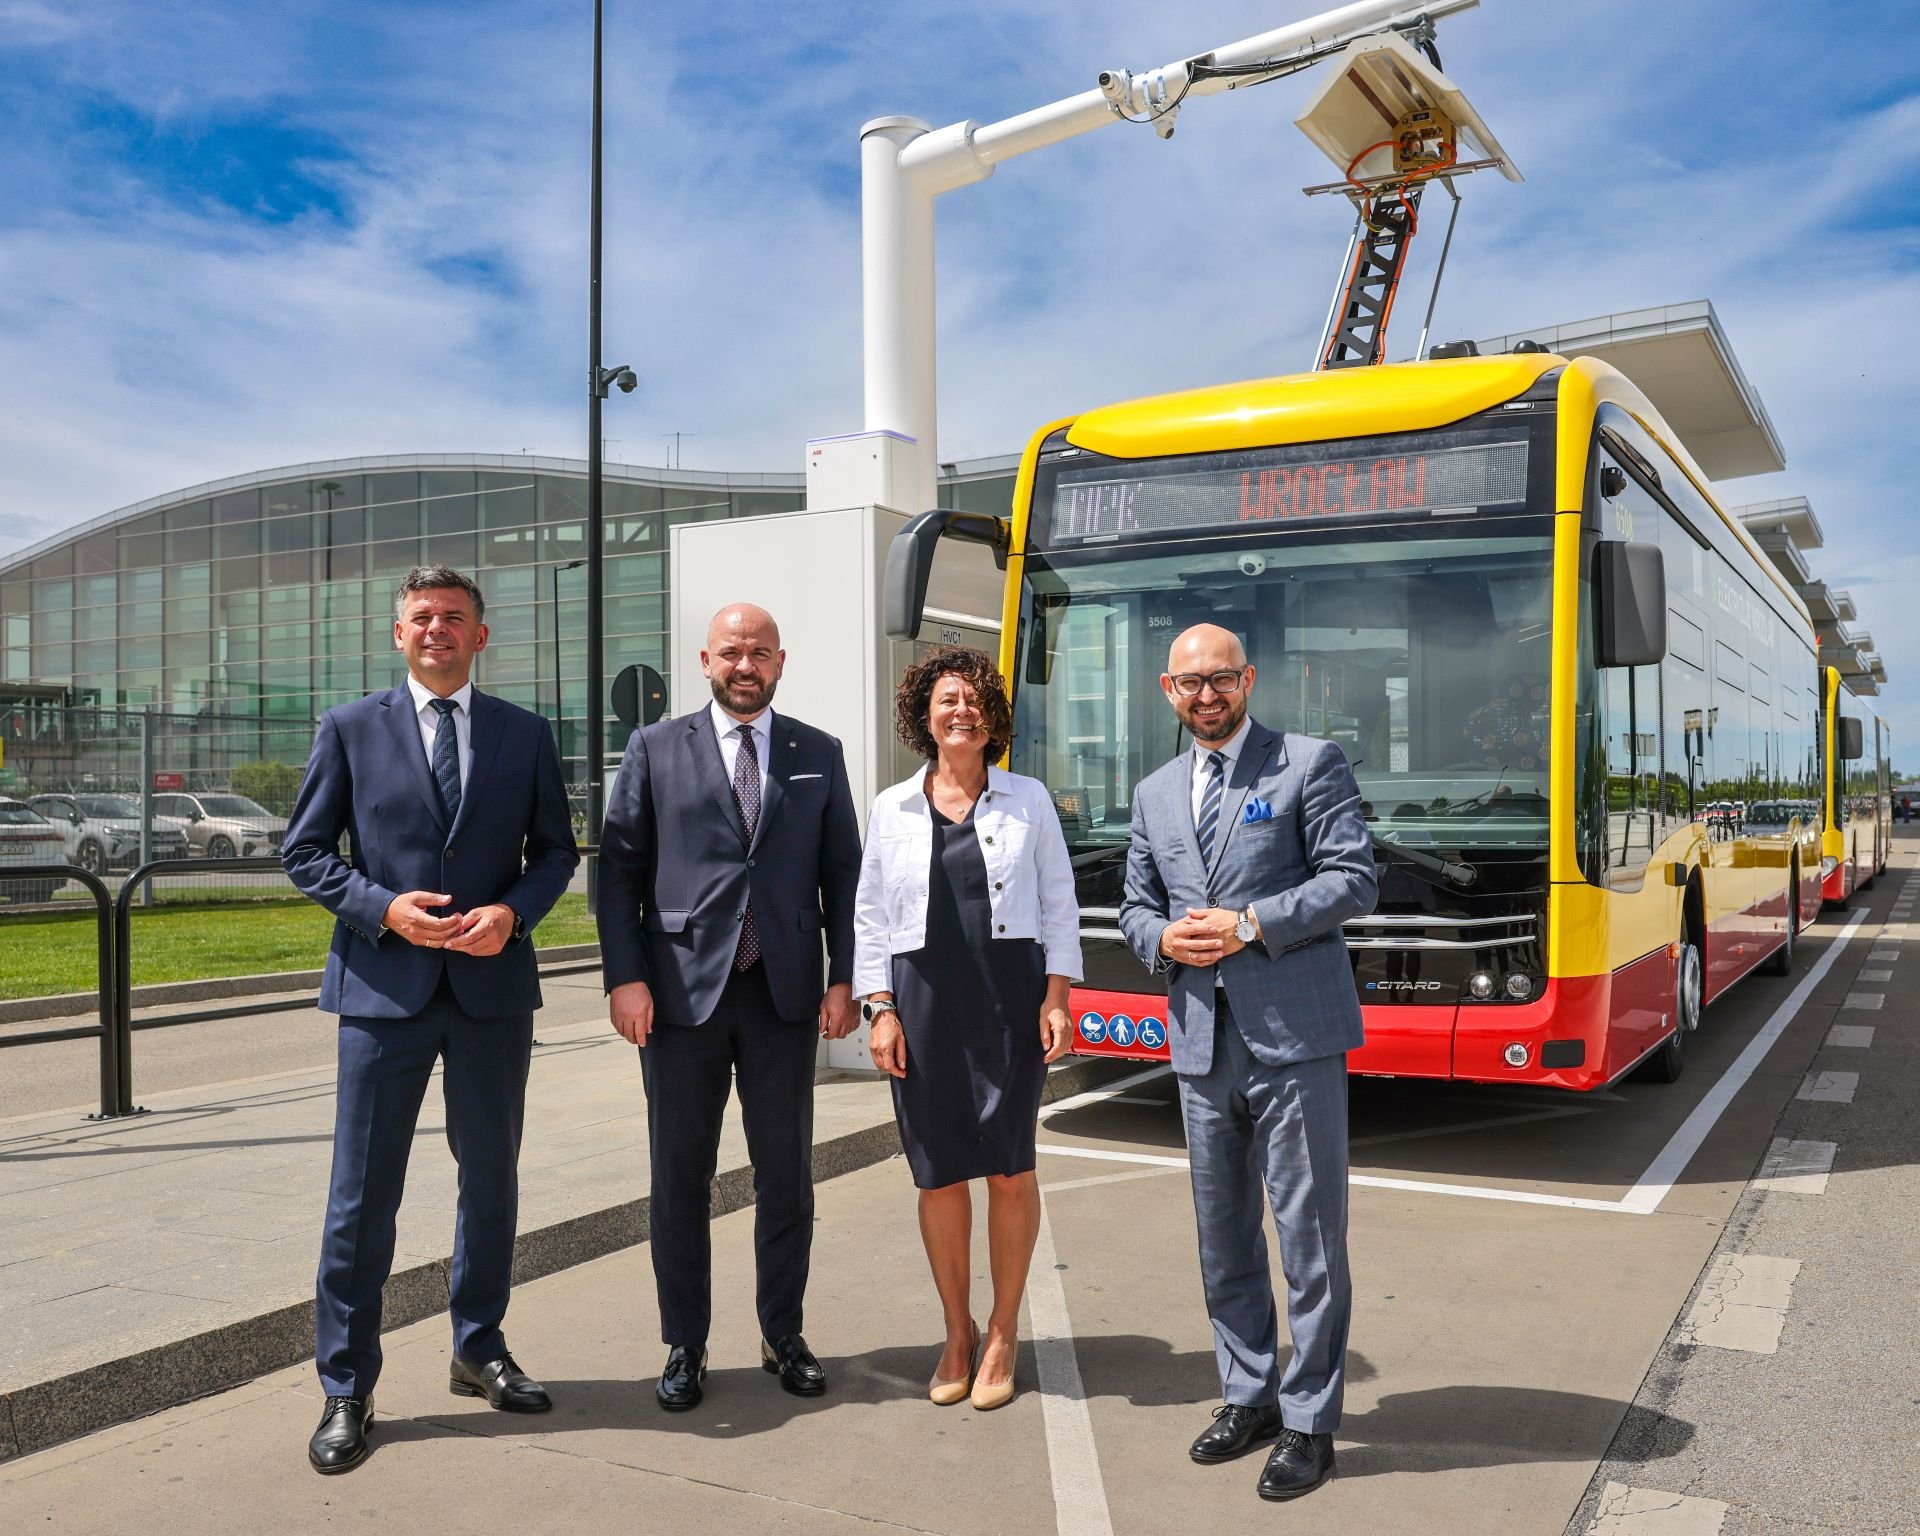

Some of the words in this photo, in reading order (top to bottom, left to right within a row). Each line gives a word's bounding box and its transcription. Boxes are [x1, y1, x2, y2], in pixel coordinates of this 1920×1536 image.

[1239, 455, 1425, 521] WROCŁAW
[942, 629, 961, 645] HVC1
[1365, 981, 1441, 990] eCITARO
